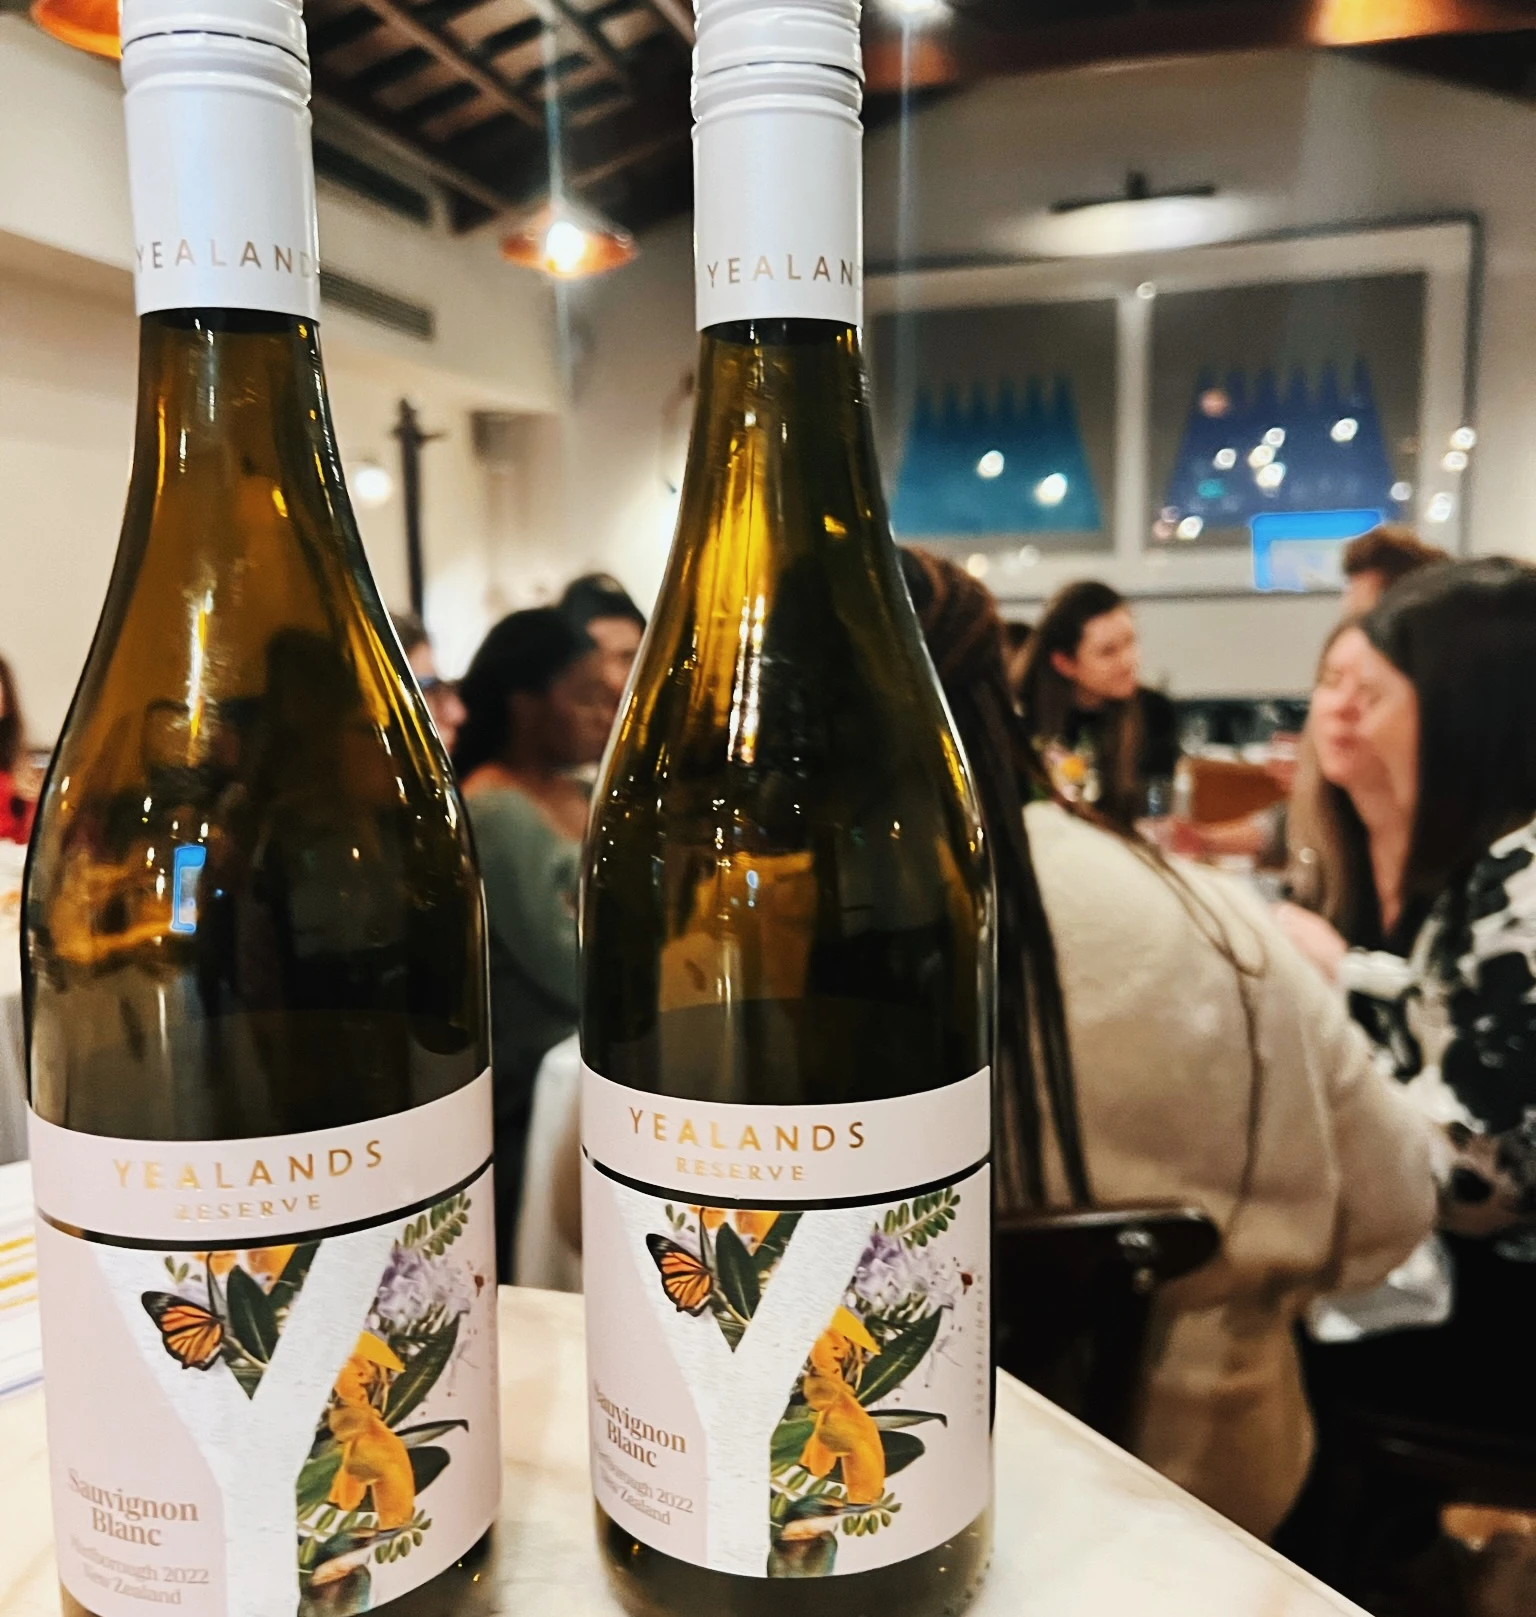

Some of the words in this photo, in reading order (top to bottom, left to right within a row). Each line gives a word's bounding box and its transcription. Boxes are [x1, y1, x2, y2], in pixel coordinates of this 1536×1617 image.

[628, 1105, 867, 1152] YEALANDS
[111, 1139, 384, 1191] YEALANDS
[674, 1156, 807, 1182] RESERVE
[606, 1417, 658, 1468] Blanc
[68, 1467, 199, 1522] Sauvignon
[90, 1506, 163, 1547] Blanc
[163, 1566, 210, 1584] 2022
